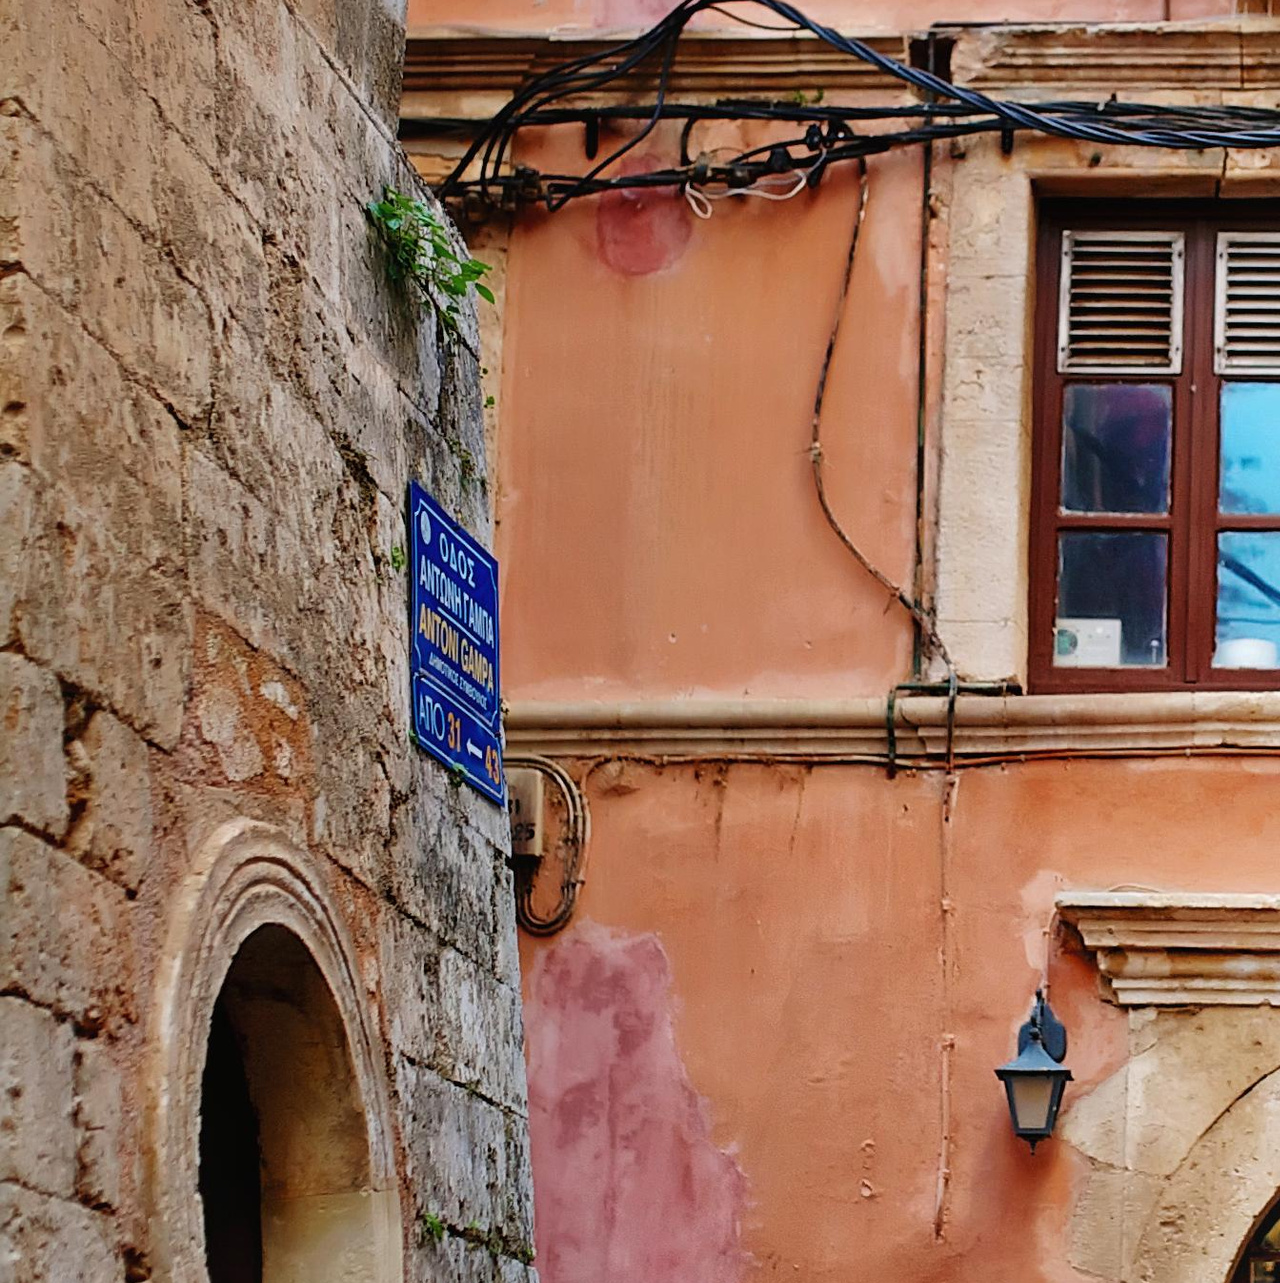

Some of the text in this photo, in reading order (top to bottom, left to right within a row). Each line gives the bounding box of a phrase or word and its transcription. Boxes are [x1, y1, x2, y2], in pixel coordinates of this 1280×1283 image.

[419, 554, 495, 649] ΑΝΤΩΝΗ ΓΑΜΠΑ
[440, 532, 476, 588] ΟΔΟΣ
[418, 603, 495, 696] ANTONI GAMPA
[419, 692, 501, 786] ΑΠΟ 31 43
